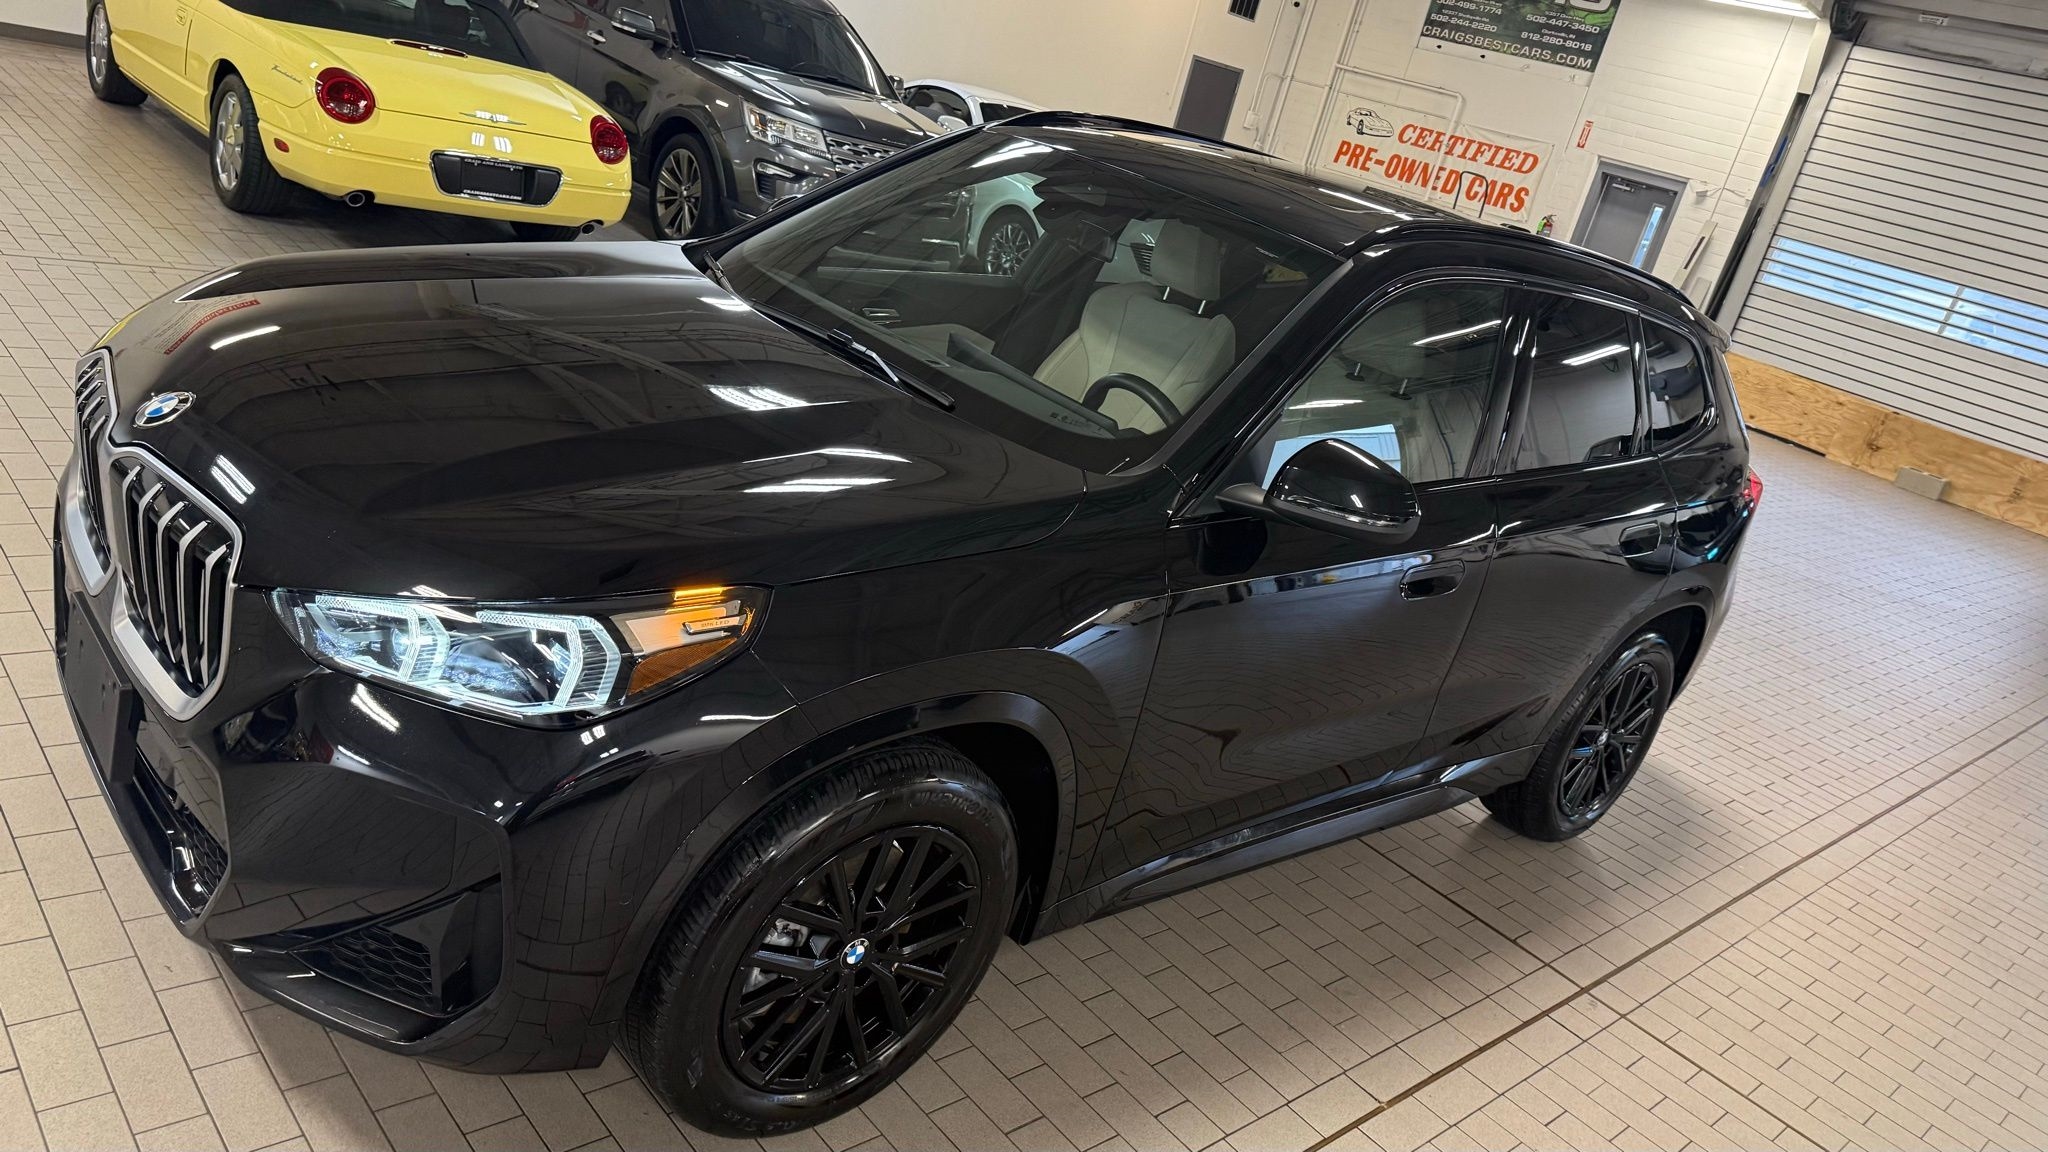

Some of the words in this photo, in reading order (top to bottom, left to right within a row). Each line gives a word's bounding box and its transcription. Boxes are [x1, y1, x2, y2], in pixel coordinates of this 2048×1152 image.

[1430, 13, 1498, 32] 502-244-2220
[1526, 14, 1601, 33] 502-447-3450
[1422, 25, 1594, 69] CRAIGSBESTCARS.COM
[1397, 123, 1539, 175] CERTIFIED
[1333, 140, 1462, 195] PRE-OWNED
[1465, 175, 1531, 213] CARS
